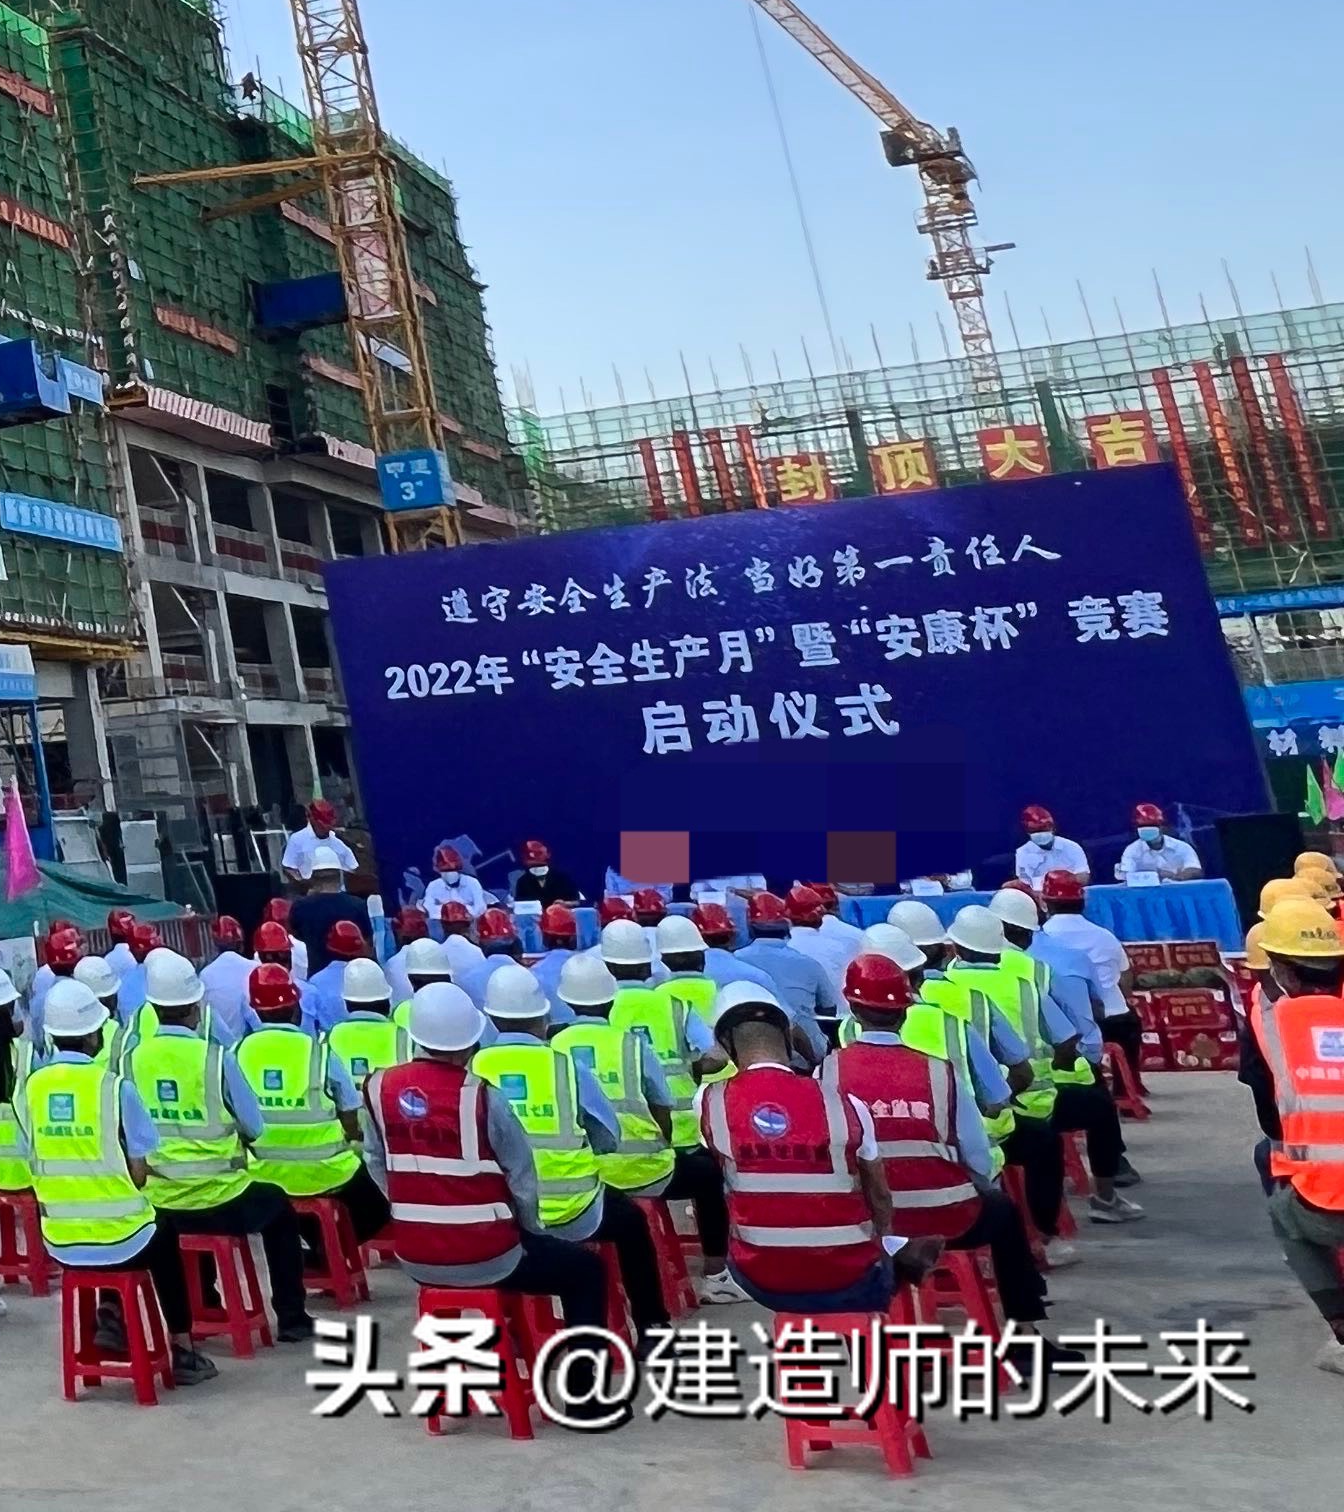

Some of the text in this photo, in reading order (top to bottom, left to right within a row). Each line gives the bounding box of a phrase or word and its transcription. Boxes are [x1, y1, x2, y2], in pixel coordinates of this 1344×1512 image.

[777, 413, 1156, 504] 封顶大吉
[440, 533, 1063, 624] 遵守安全生产法 当好第一责任人
[642, 682, 900, 754] 启动仪式
